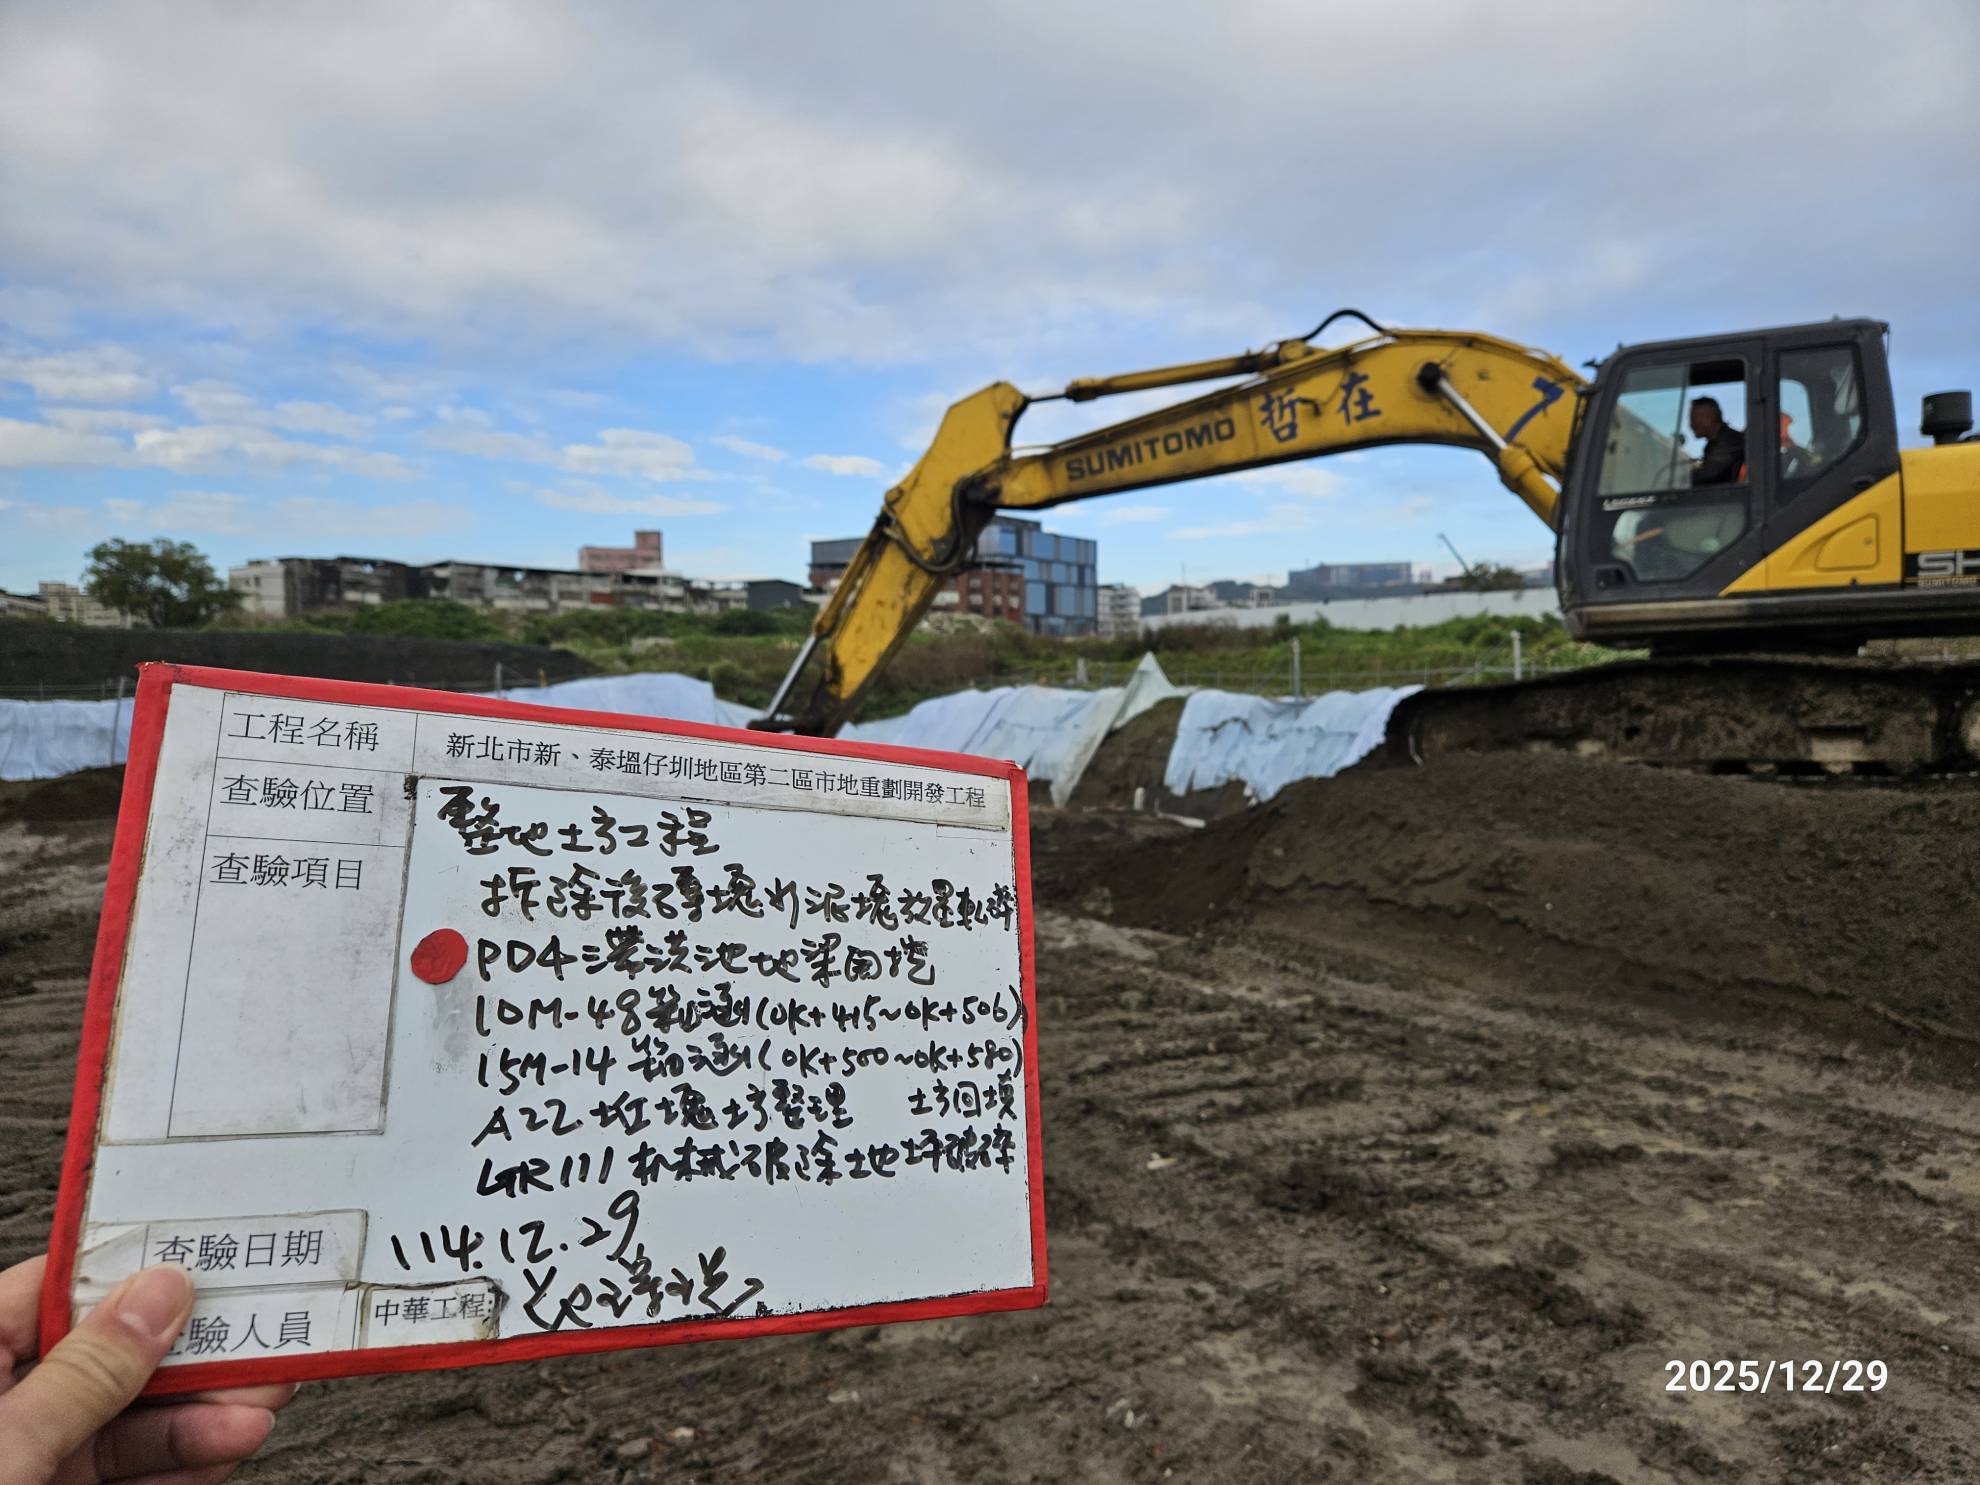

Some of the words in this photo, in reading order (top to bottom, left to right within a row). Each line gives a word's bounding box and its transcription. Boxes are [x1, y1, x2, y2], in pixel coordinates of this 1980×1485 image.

[1065, 418, 1236, 481] SUMITOMO
[228, 712, 380, 752] 工程名稱
[446, 732, 986, 809] 新北市新、泰塭仔圳地區第二區市地重劃開發工程
[219, 774, 374, 815] 查驗位置
[209, 852, 363, 891] 查驗項目
[390, 1189, 640, 1272] 114.12.29
[375, 1293, 485, 1326] 中華工程
[170, 1310, 312, 1356] 驗人員
